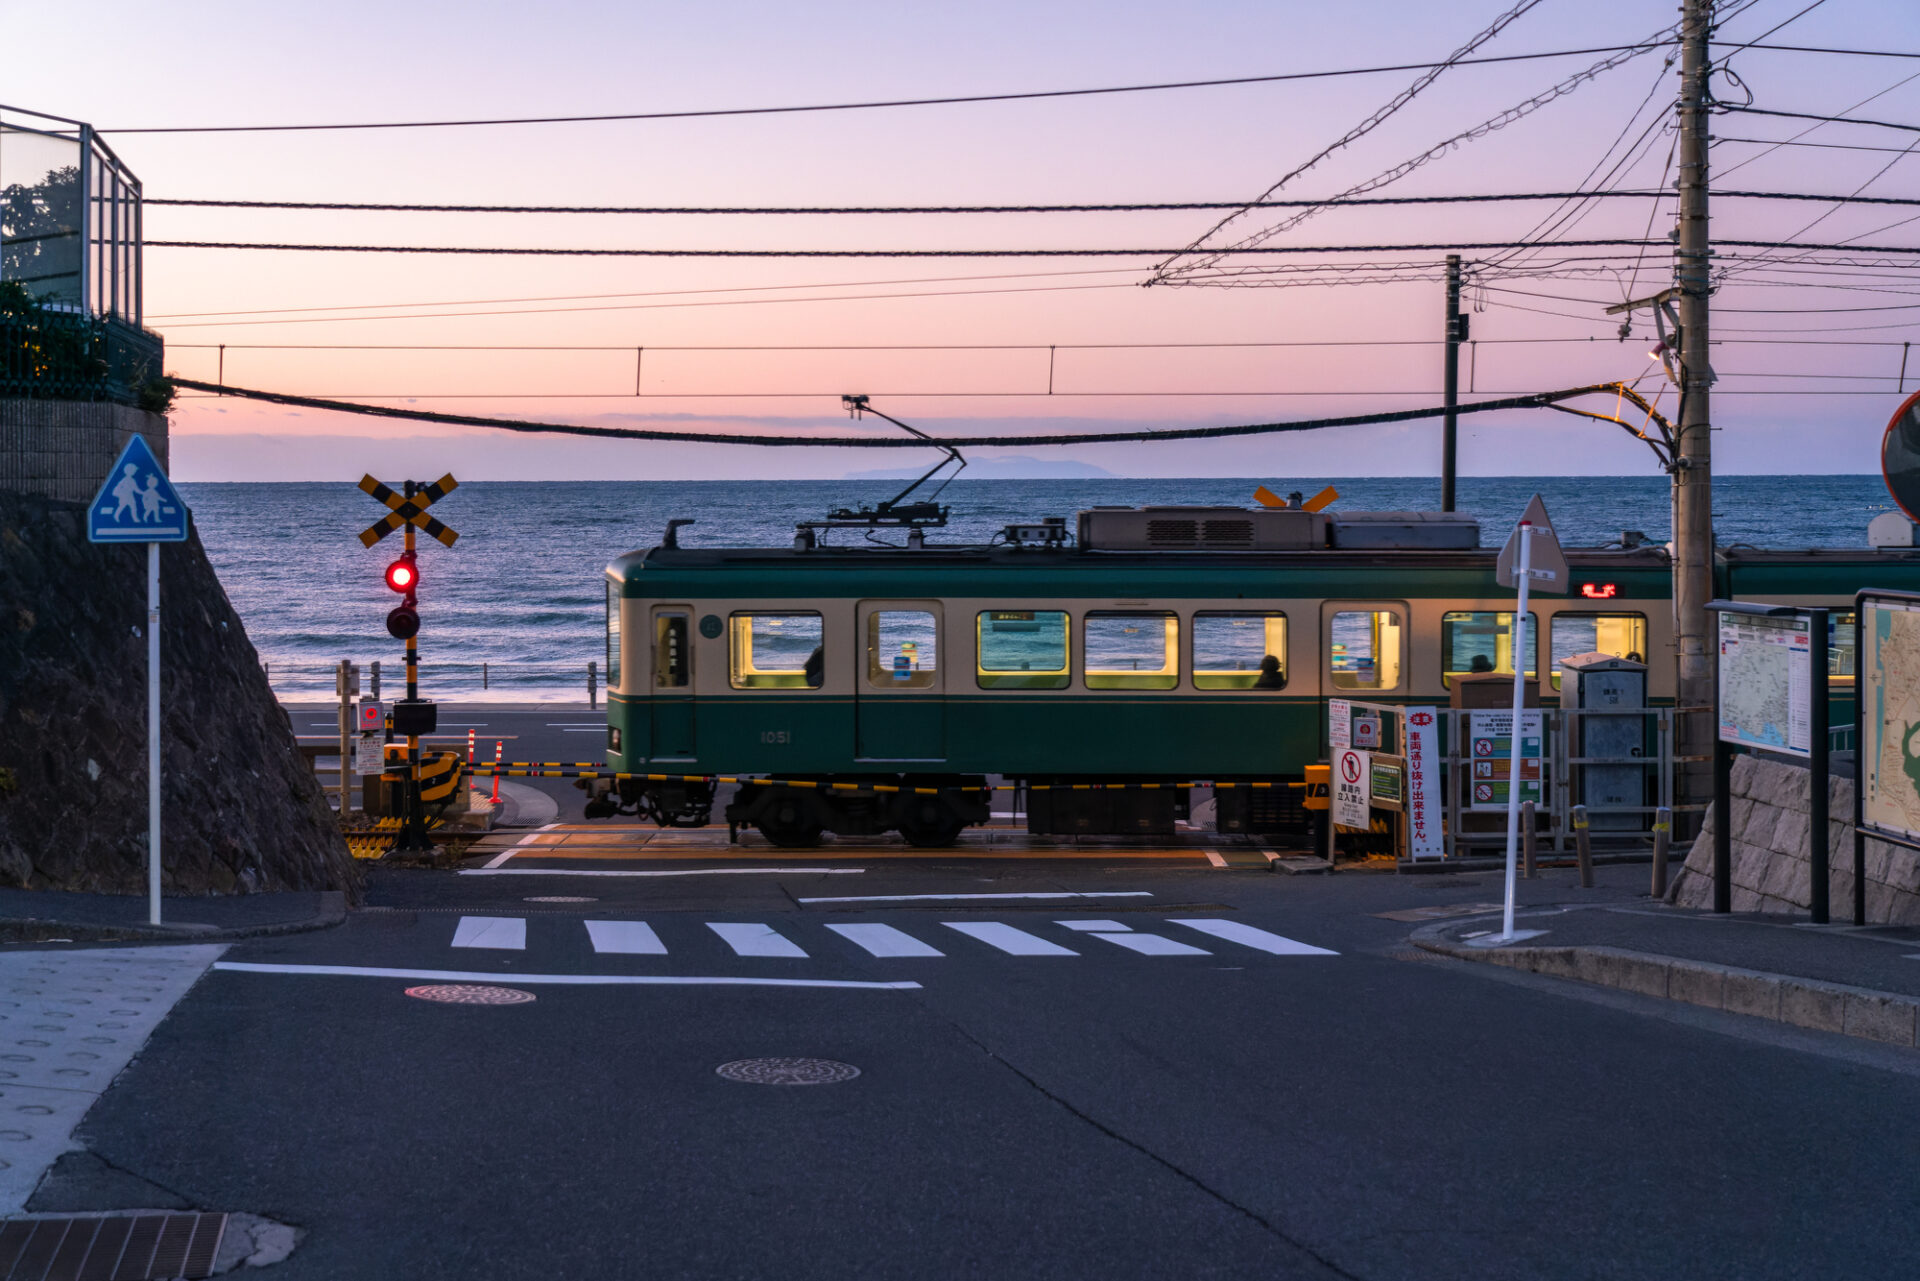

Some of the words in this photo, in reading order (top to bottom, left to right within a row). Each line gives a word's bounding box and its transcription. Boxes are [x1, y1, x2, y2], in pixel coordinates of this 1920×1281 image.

[761, 731, 790, 744] 1051
[1409, 731, 1427, 843] 車両通り抜け出来ません。
[1337, 792, 1364, 805] 立入禁止
